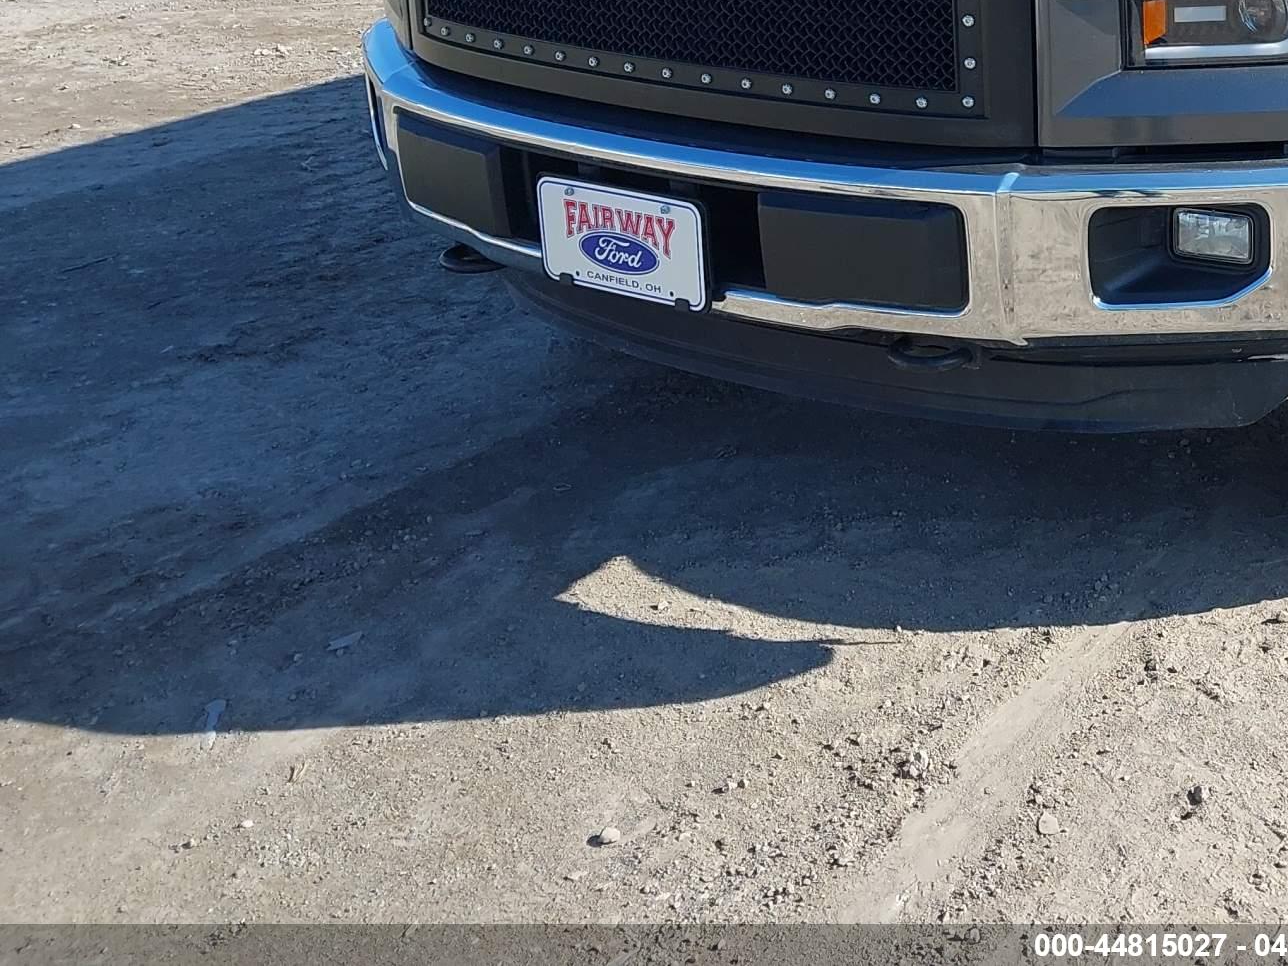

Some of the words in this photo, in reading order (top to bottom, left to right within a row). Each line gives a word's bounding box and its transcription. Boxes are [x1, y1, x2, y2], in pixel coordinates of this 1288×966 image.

[562, 198, 676, 259] FAIRWAY
[594, 236, 643, 268] Ford
[587, 270, 643, 291] CANFIELD,
[645, 283, 662, 294] OH
